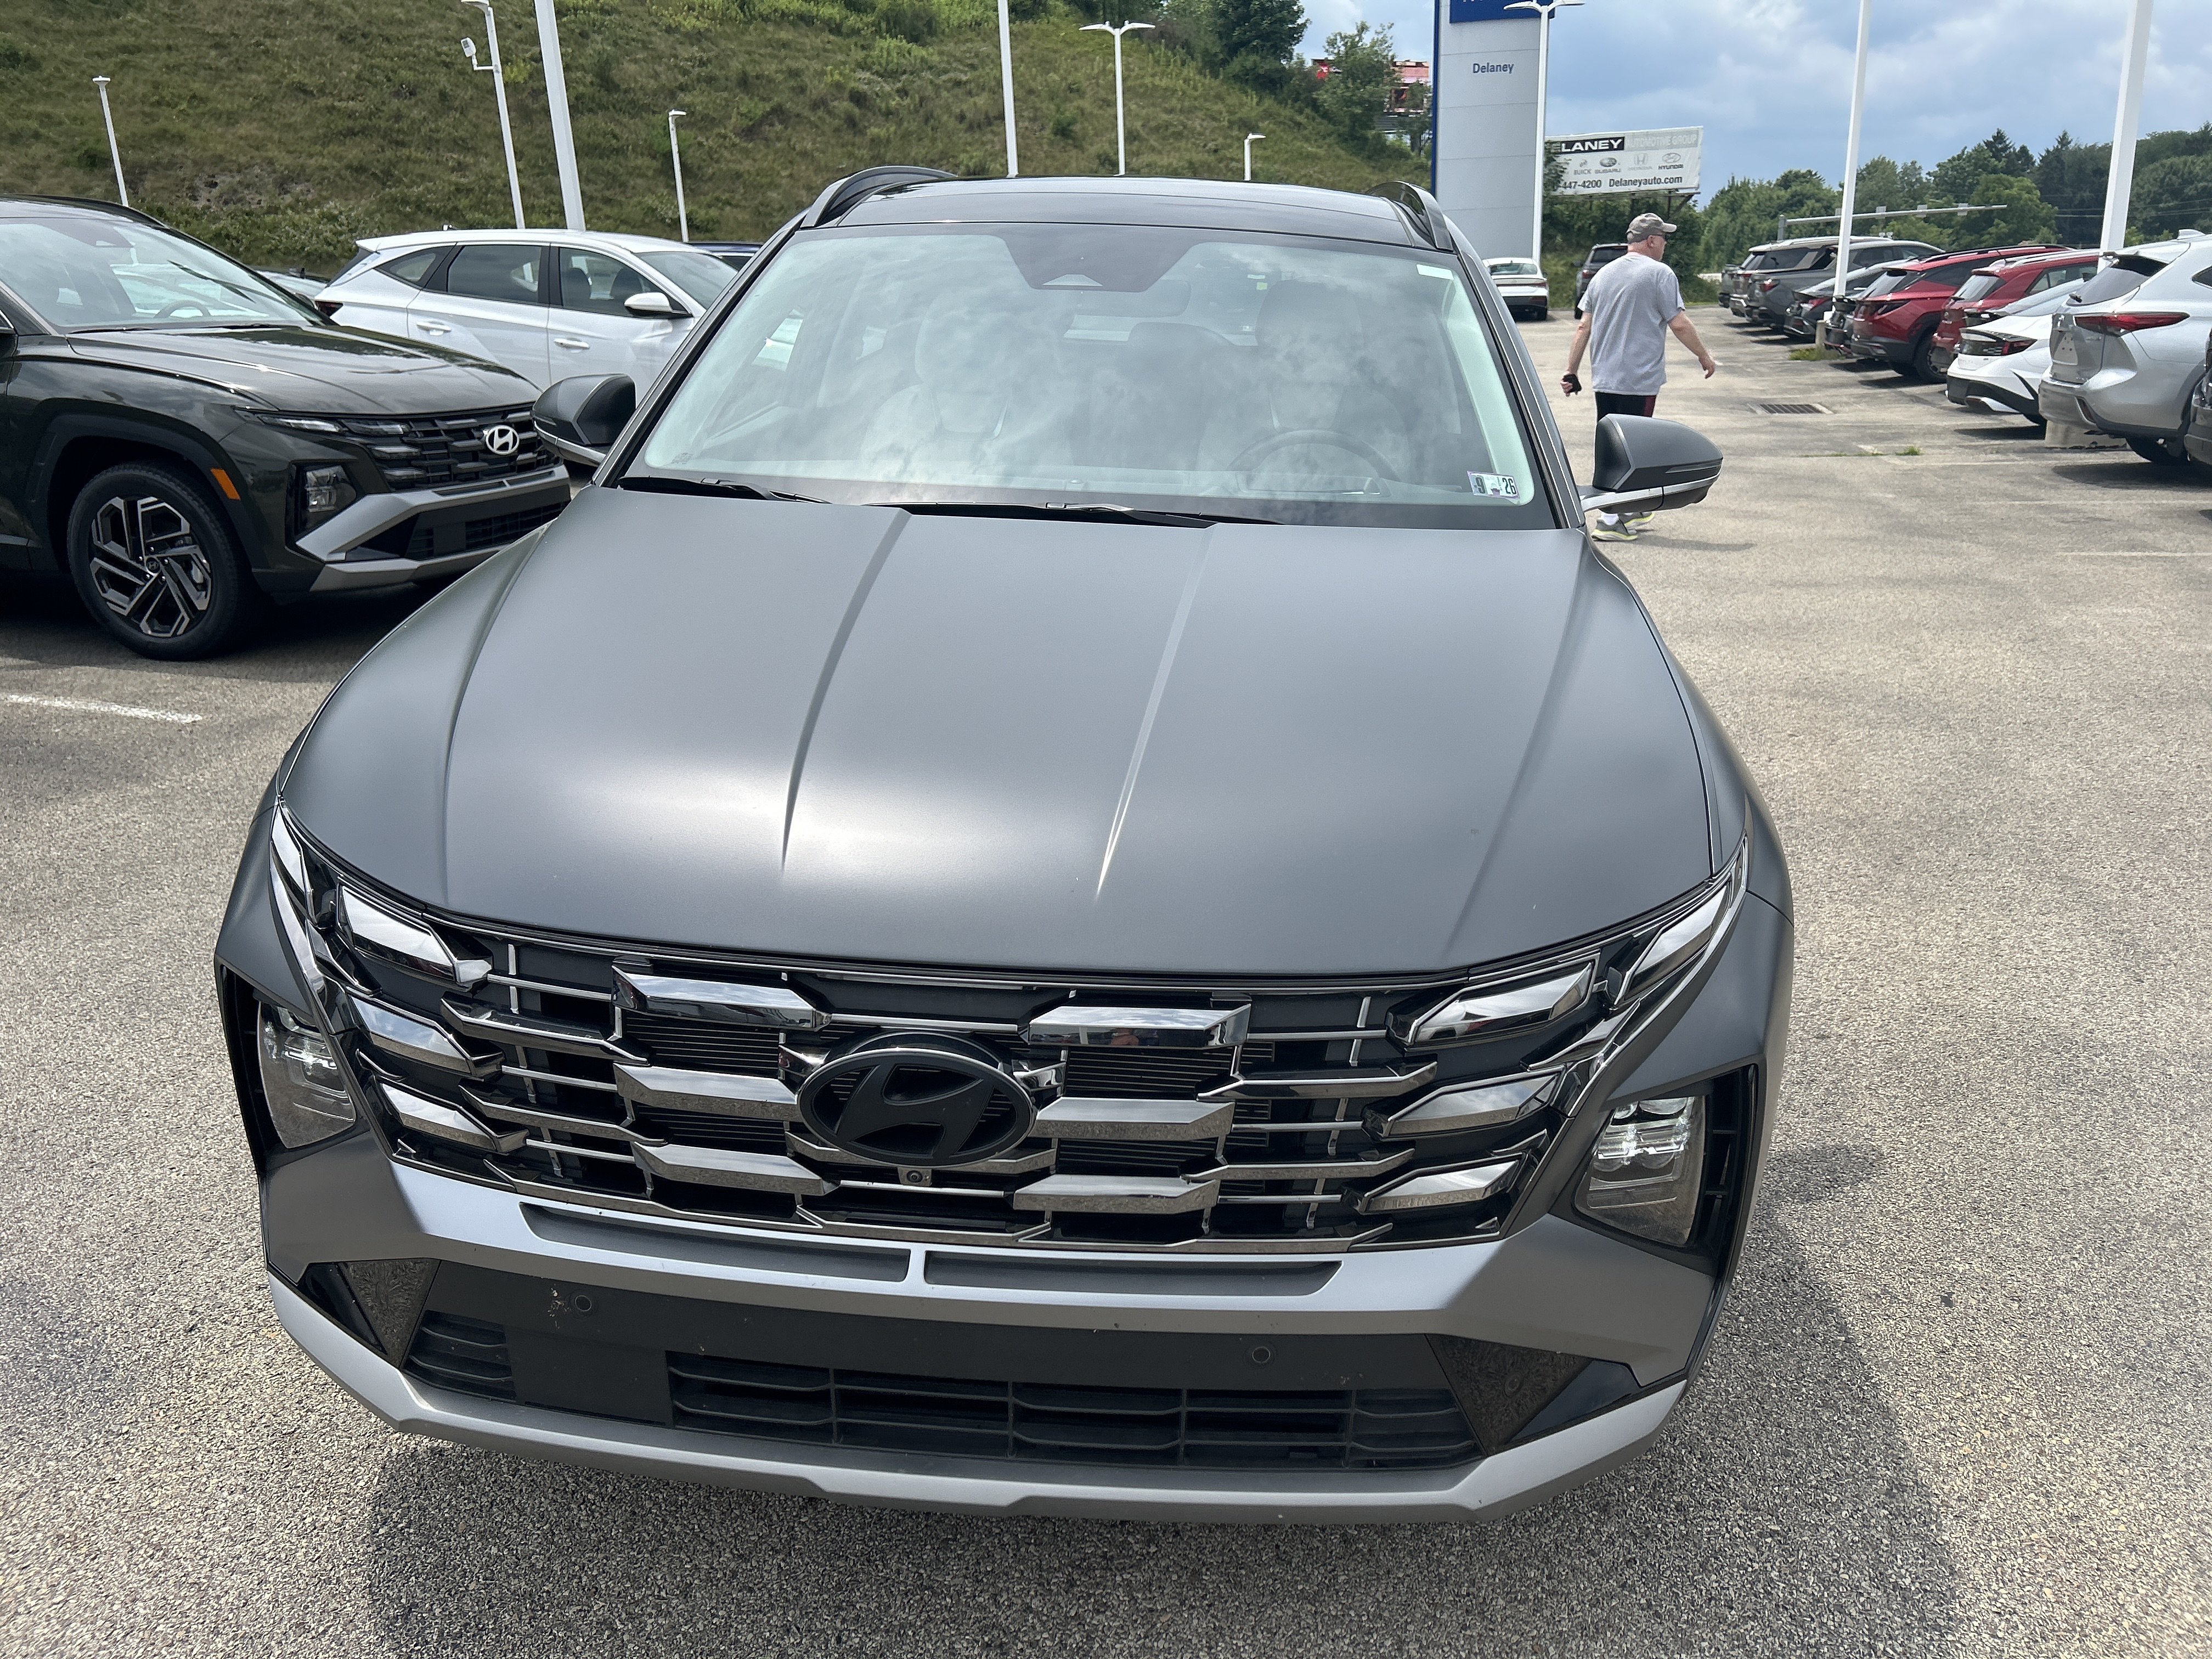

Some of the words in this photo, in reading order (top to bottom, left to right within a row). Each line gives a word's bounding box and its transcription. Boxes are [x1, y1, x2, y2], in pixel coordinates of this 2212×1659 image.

[1472, 62, 1514, 74] Delaney
[1609, 176, 1683, 188] Delaneyauto.com
[1502, 477, 1517, 495] 26
